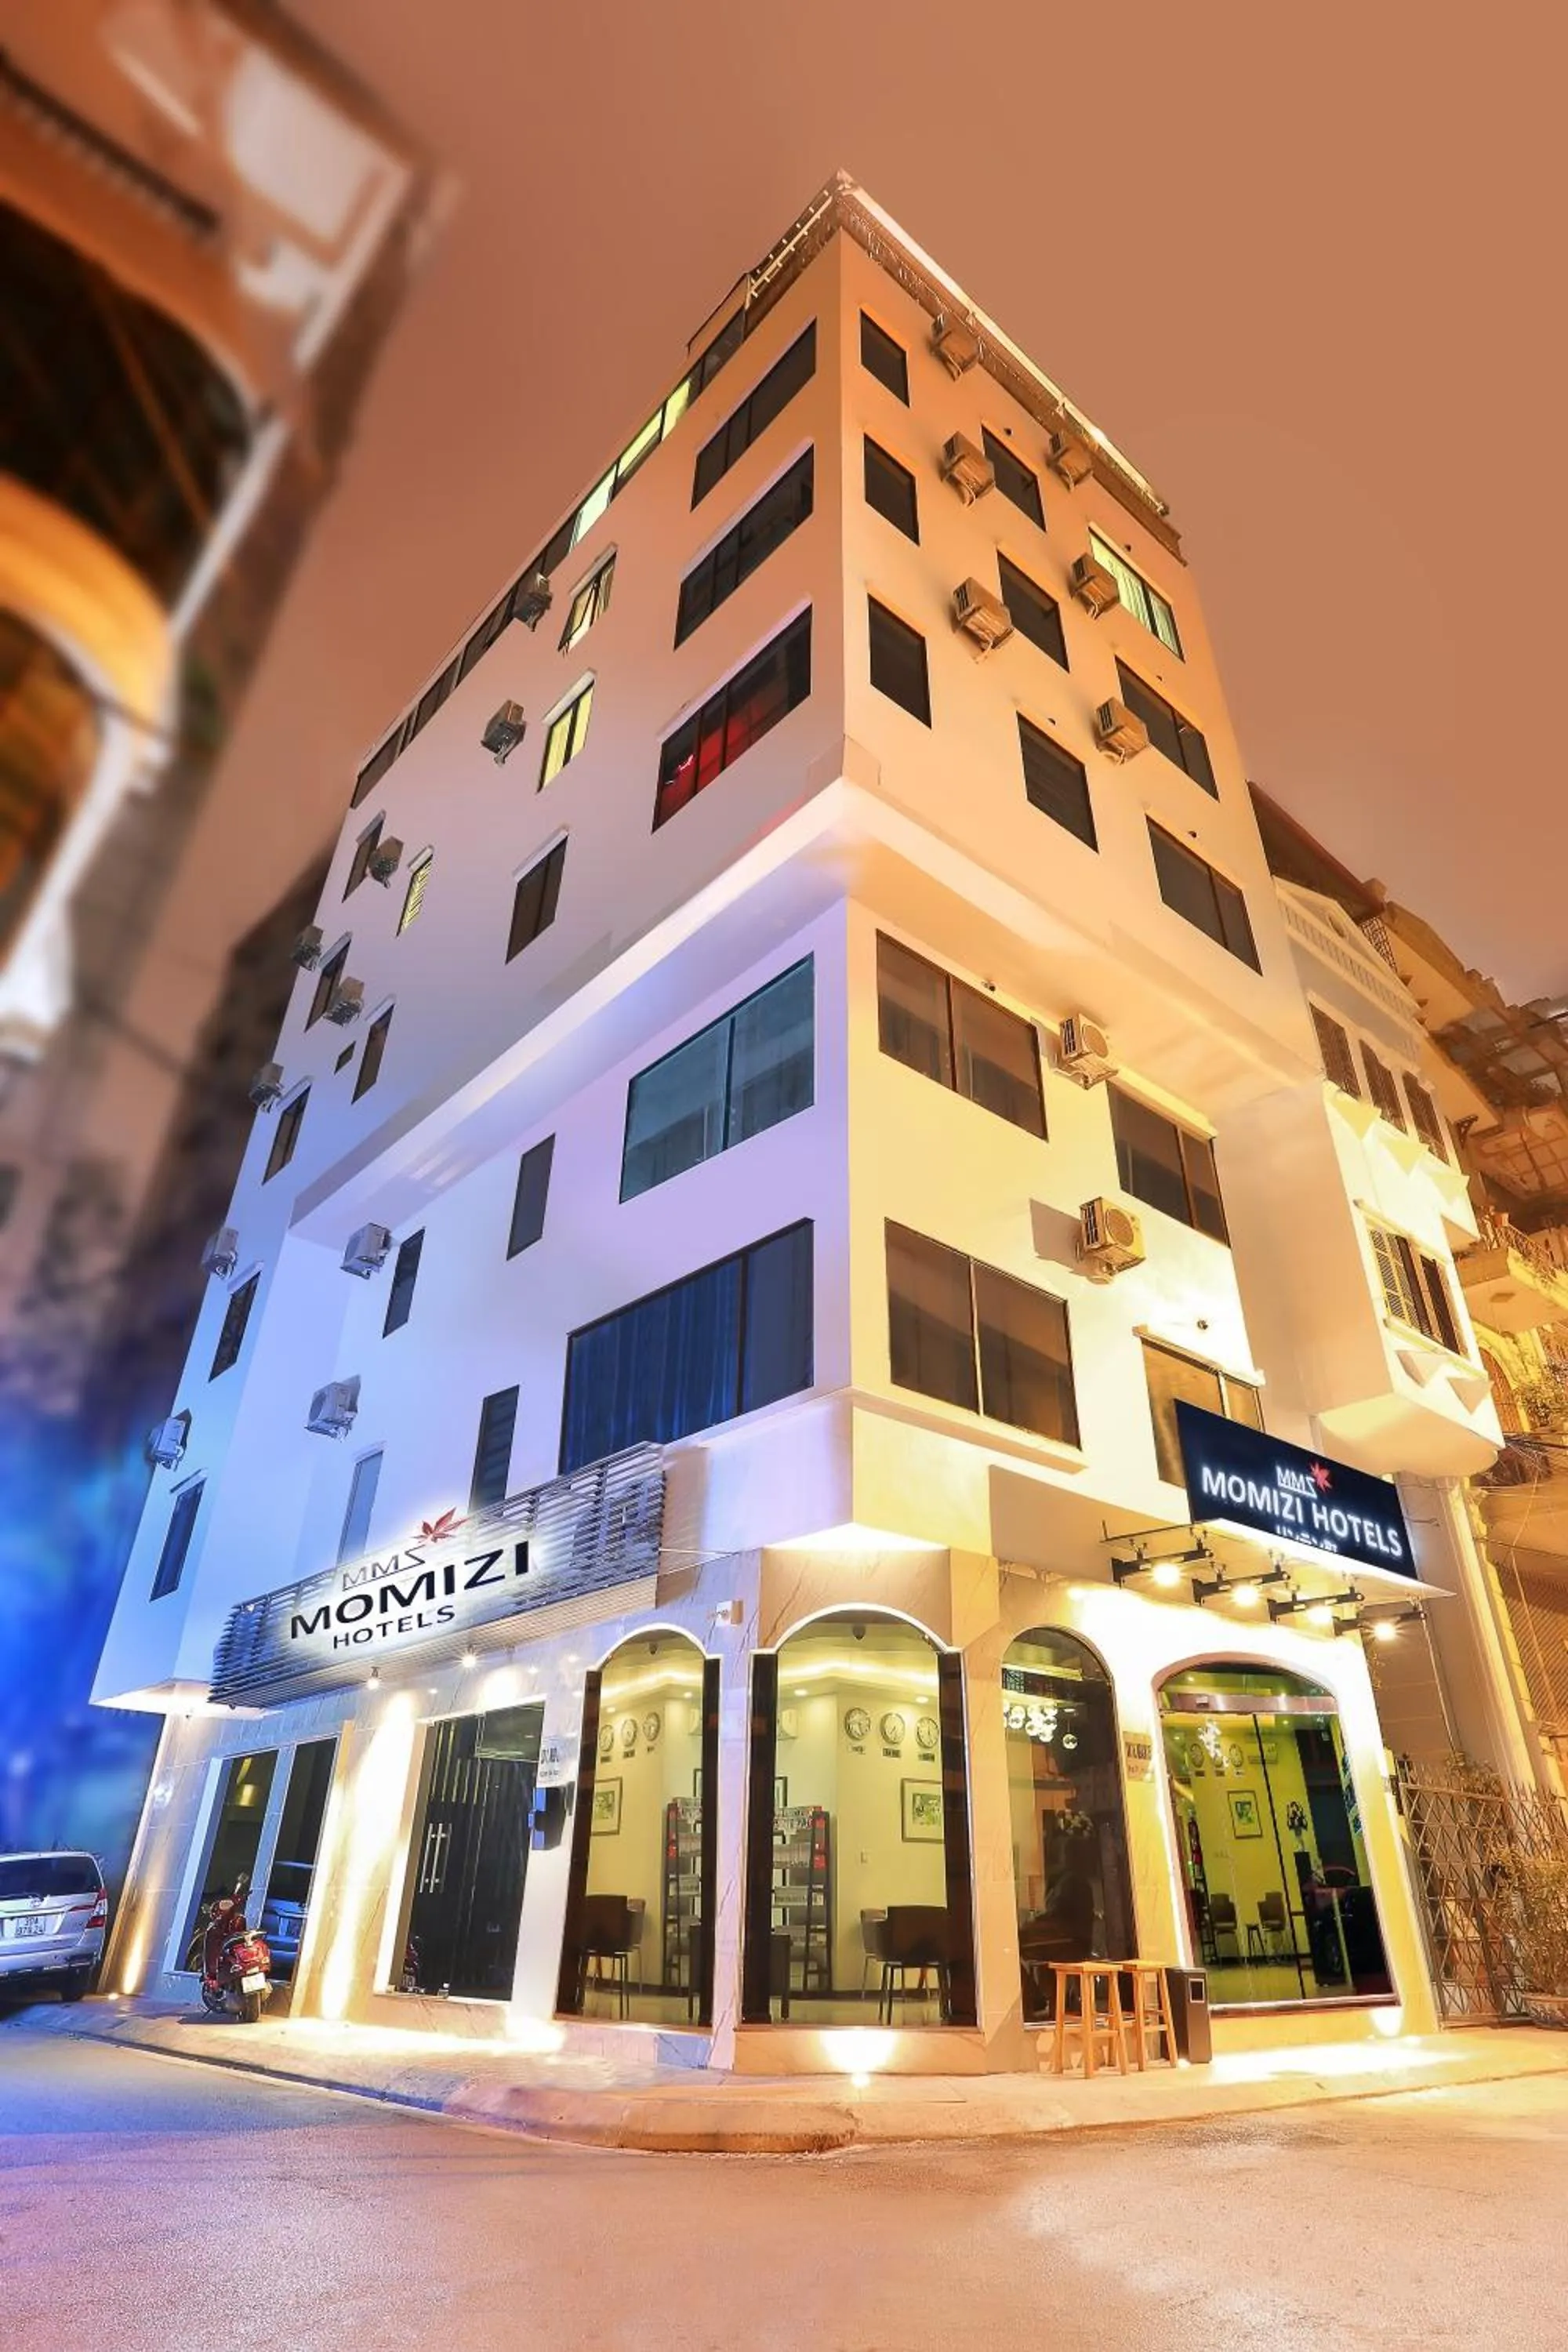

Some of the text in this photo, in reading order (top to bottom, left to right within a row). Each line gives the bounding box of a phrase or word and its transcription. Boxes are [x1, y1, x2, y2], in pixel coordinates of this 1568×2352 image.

[1201, 1467, 1304, 1523] MOMIZI
[1311, 1503, 1403, 1557] HOTELS
[290, 1541, 529, 1639] MOMIZI
[332, 1605, 456, 1650] HOTELS
